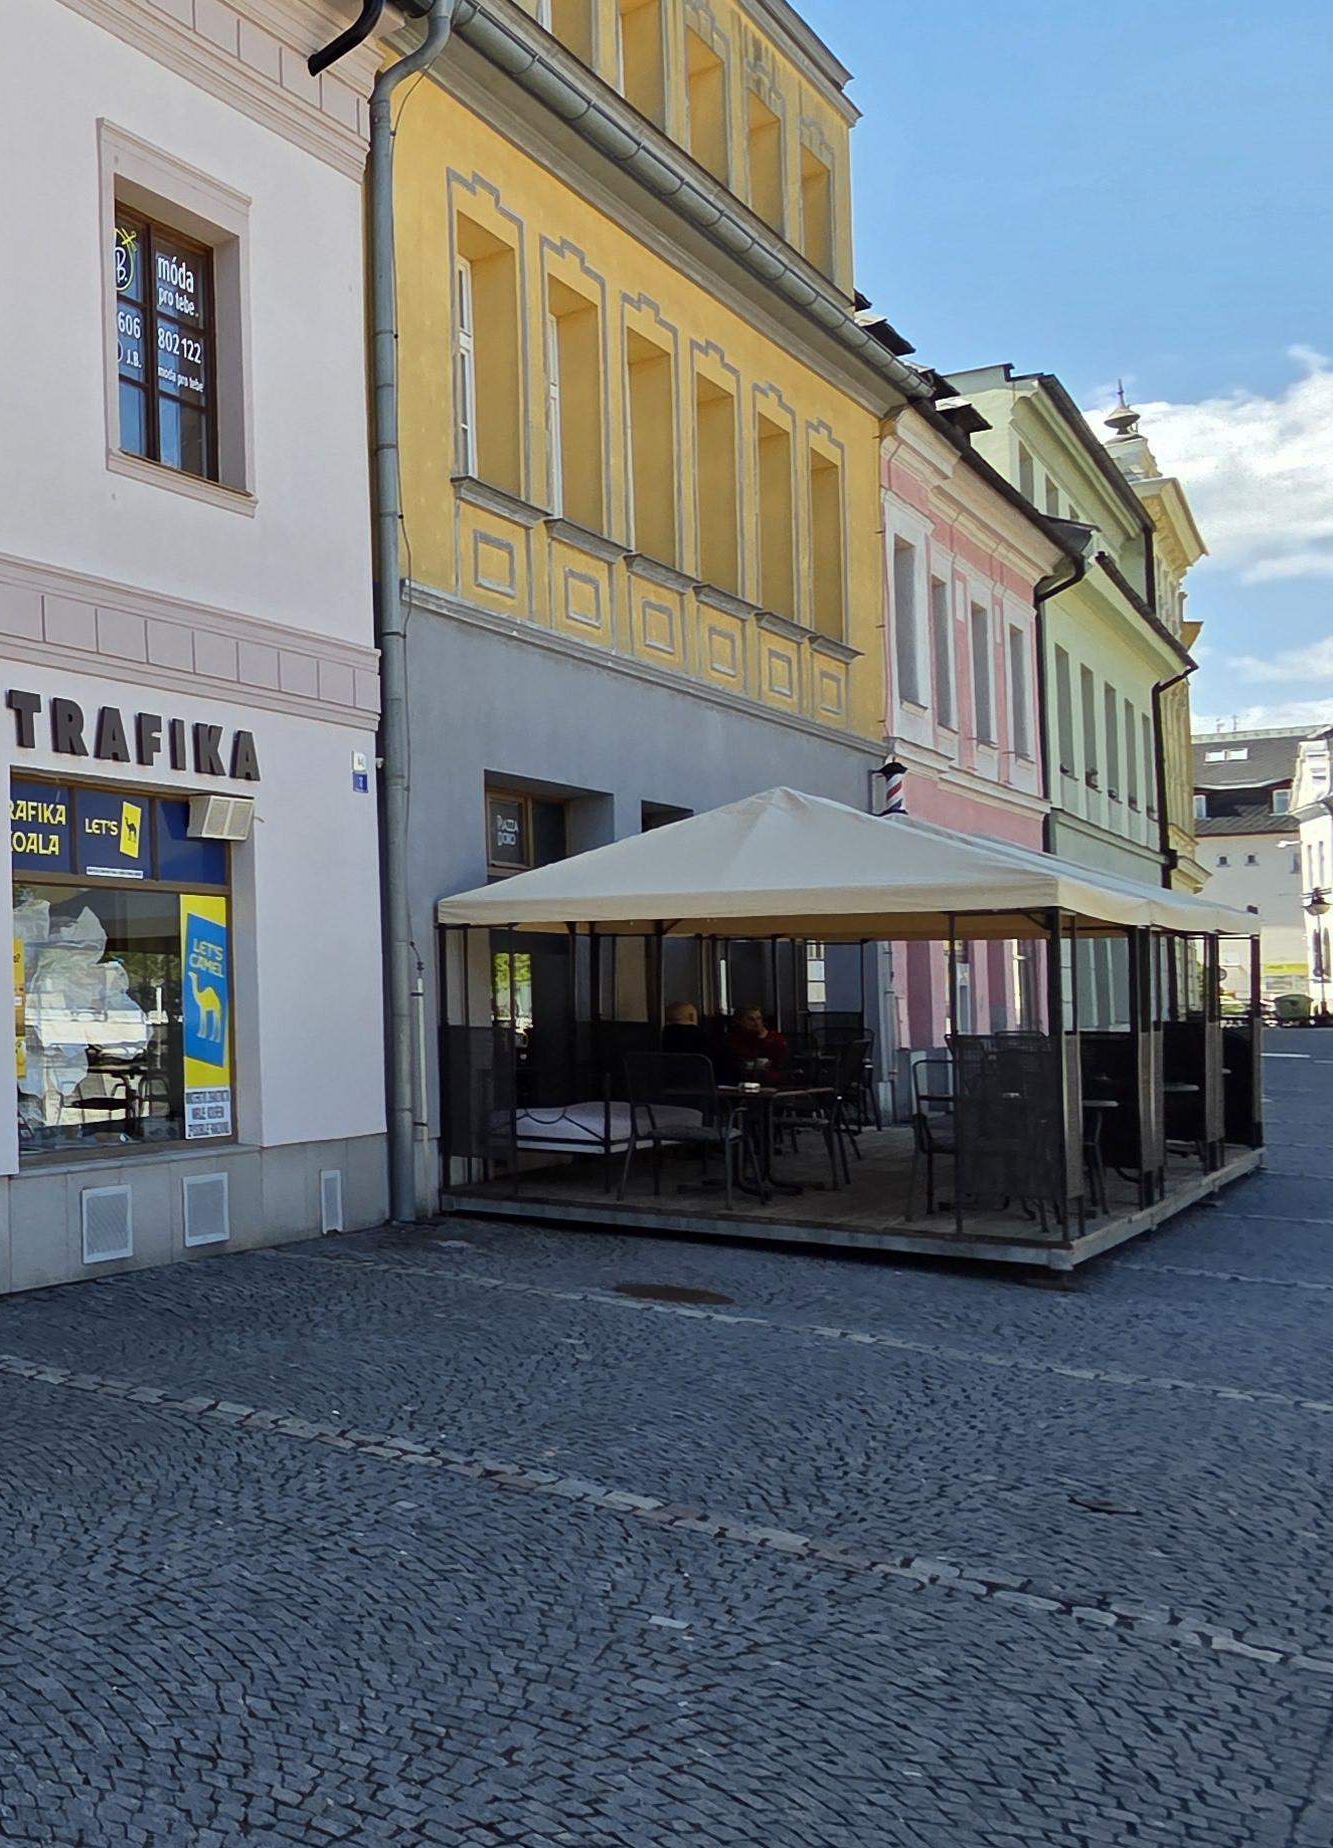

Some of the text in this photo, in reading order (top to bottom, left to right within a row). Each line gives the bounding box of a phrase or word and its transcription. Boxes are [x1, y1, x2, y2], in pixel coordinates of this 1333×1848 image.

[157, 256, 195, 294] móda
[158, 287, 174, 306] pro
[118, 311, 202, 365] 606 802 122
[6, 689, 261, 781] TRAFIKA
[85, 817, 119, 836] LET'S
[10, 831, 60, 856] OALA
